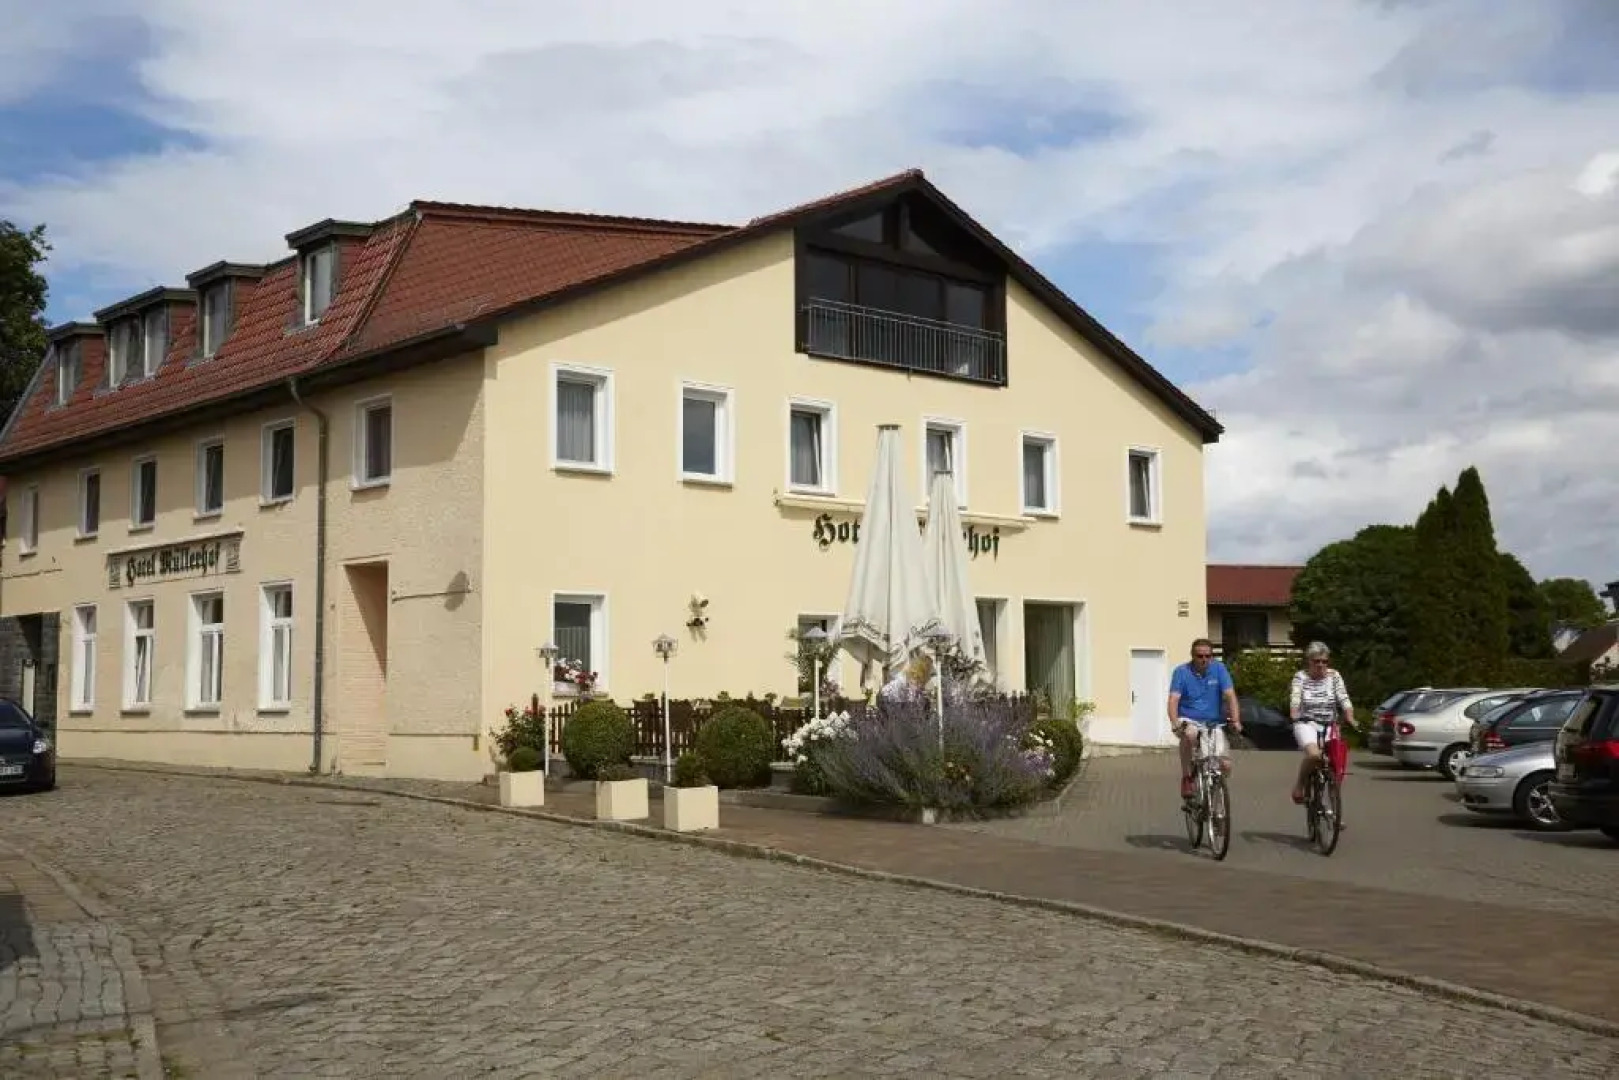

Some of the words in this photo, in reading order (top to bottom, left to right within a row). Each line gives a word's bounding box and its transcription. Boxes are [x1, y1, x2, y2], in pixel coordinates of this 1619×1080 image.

[813, 513, 861, 551] Hot
[127, 551, 156, 587] Hotel
[160, 542, 221, 576] Müllerhof
